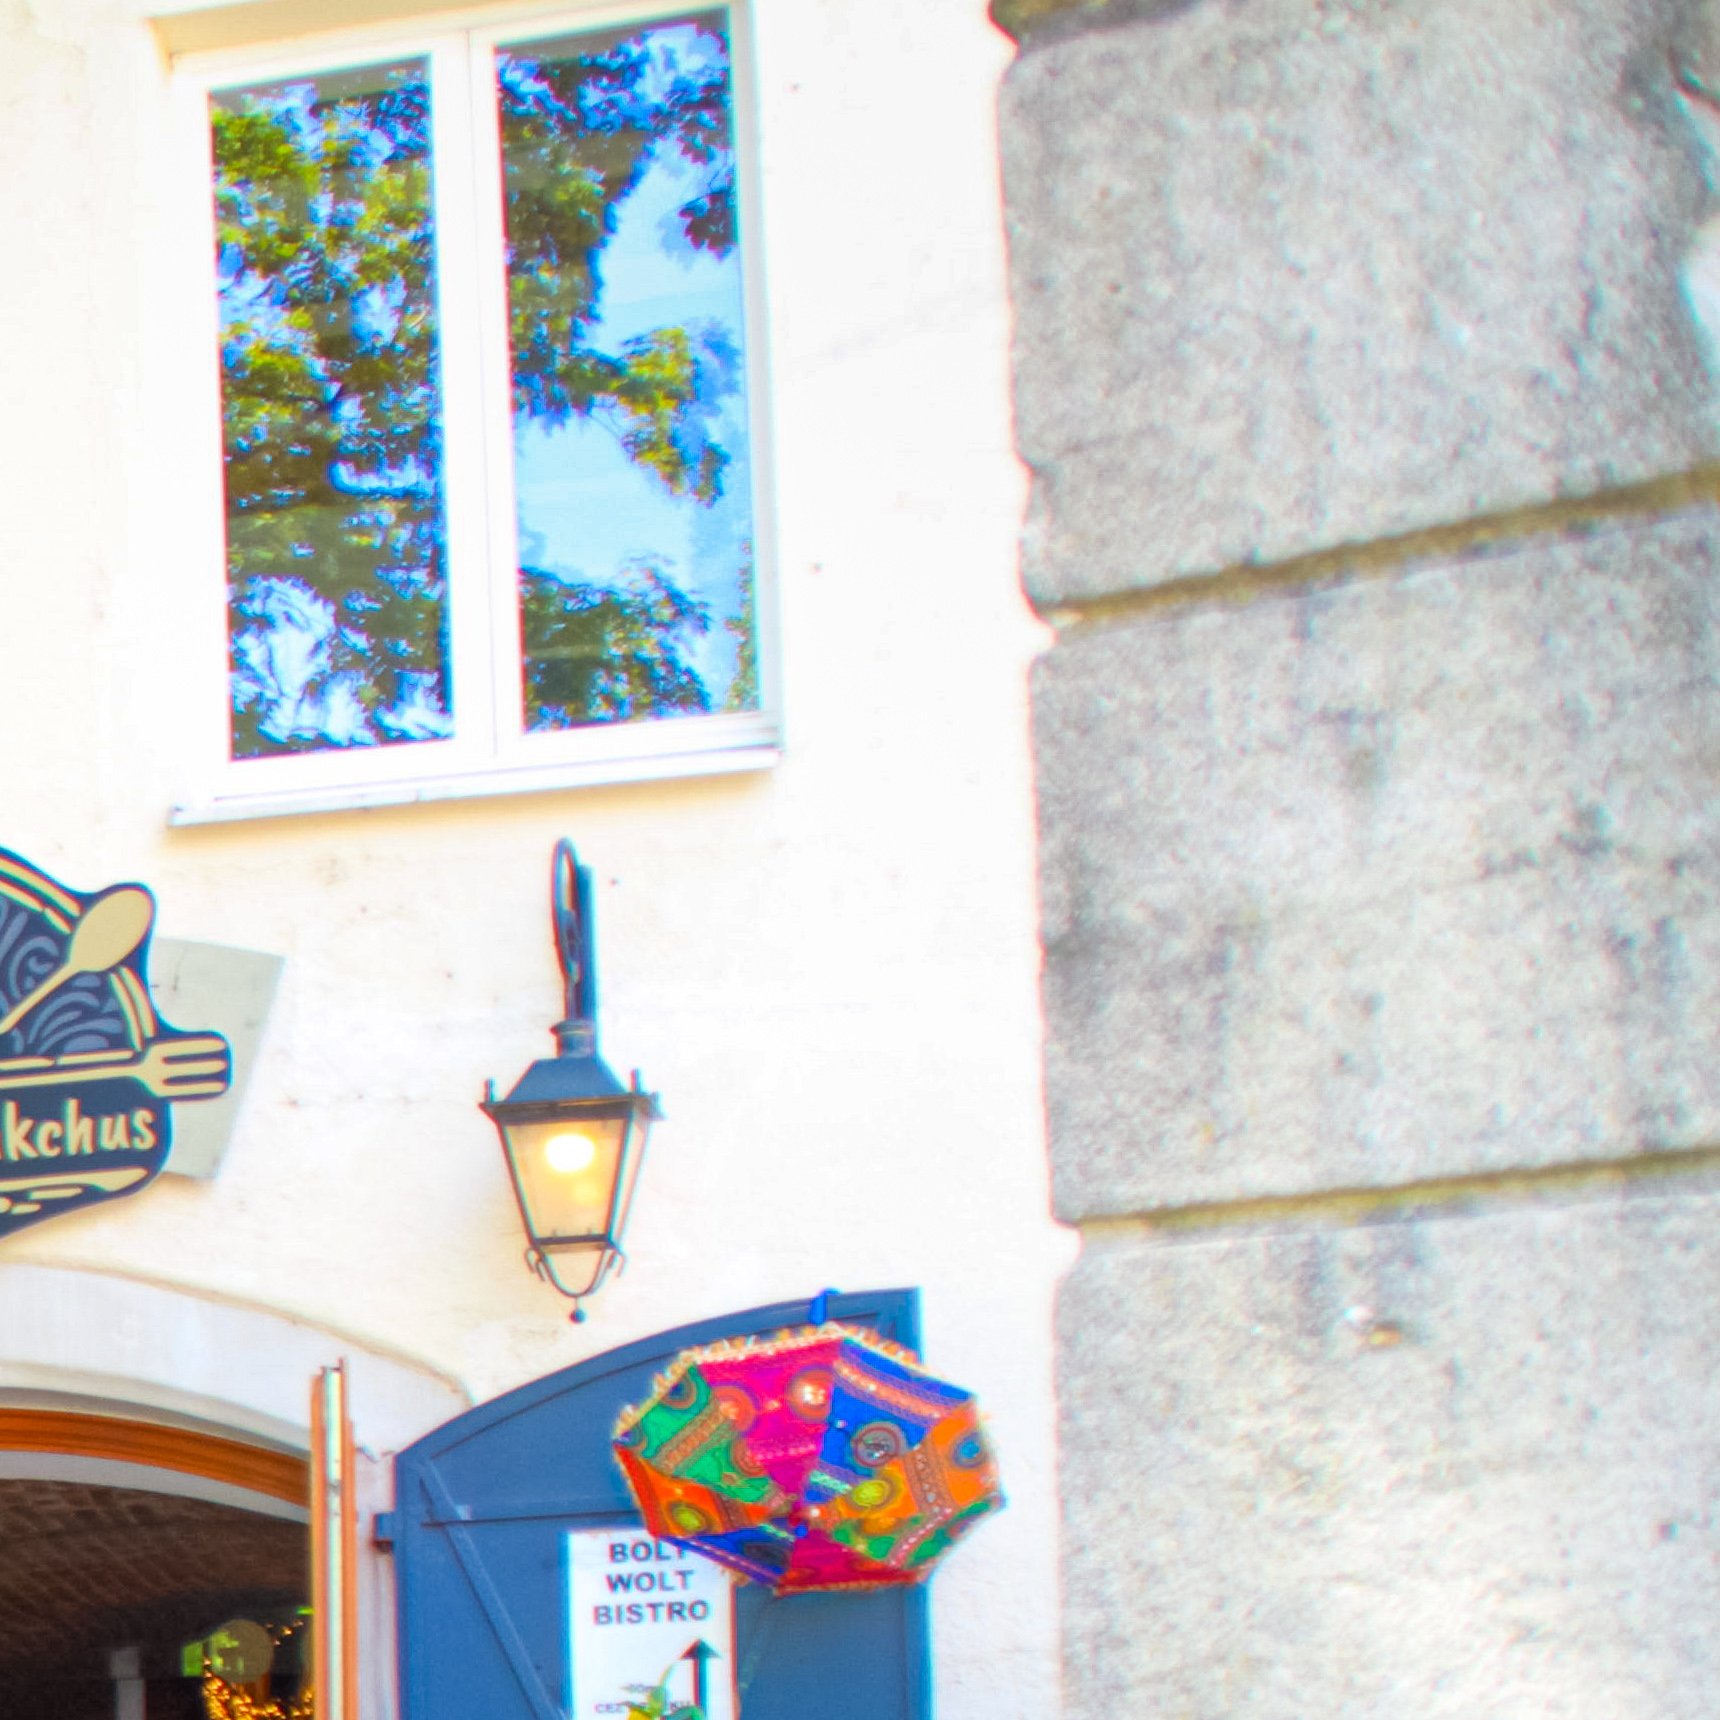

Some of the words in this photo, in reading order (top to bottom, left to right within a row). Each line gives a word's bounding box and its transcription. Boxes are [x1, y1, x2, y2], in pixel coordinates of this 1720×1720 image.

[609, 1541, 690, 1563] BOLT
[606, 1569, 694, 1592] WOLT
[592, 1599, 710, 1626] BISTRO
